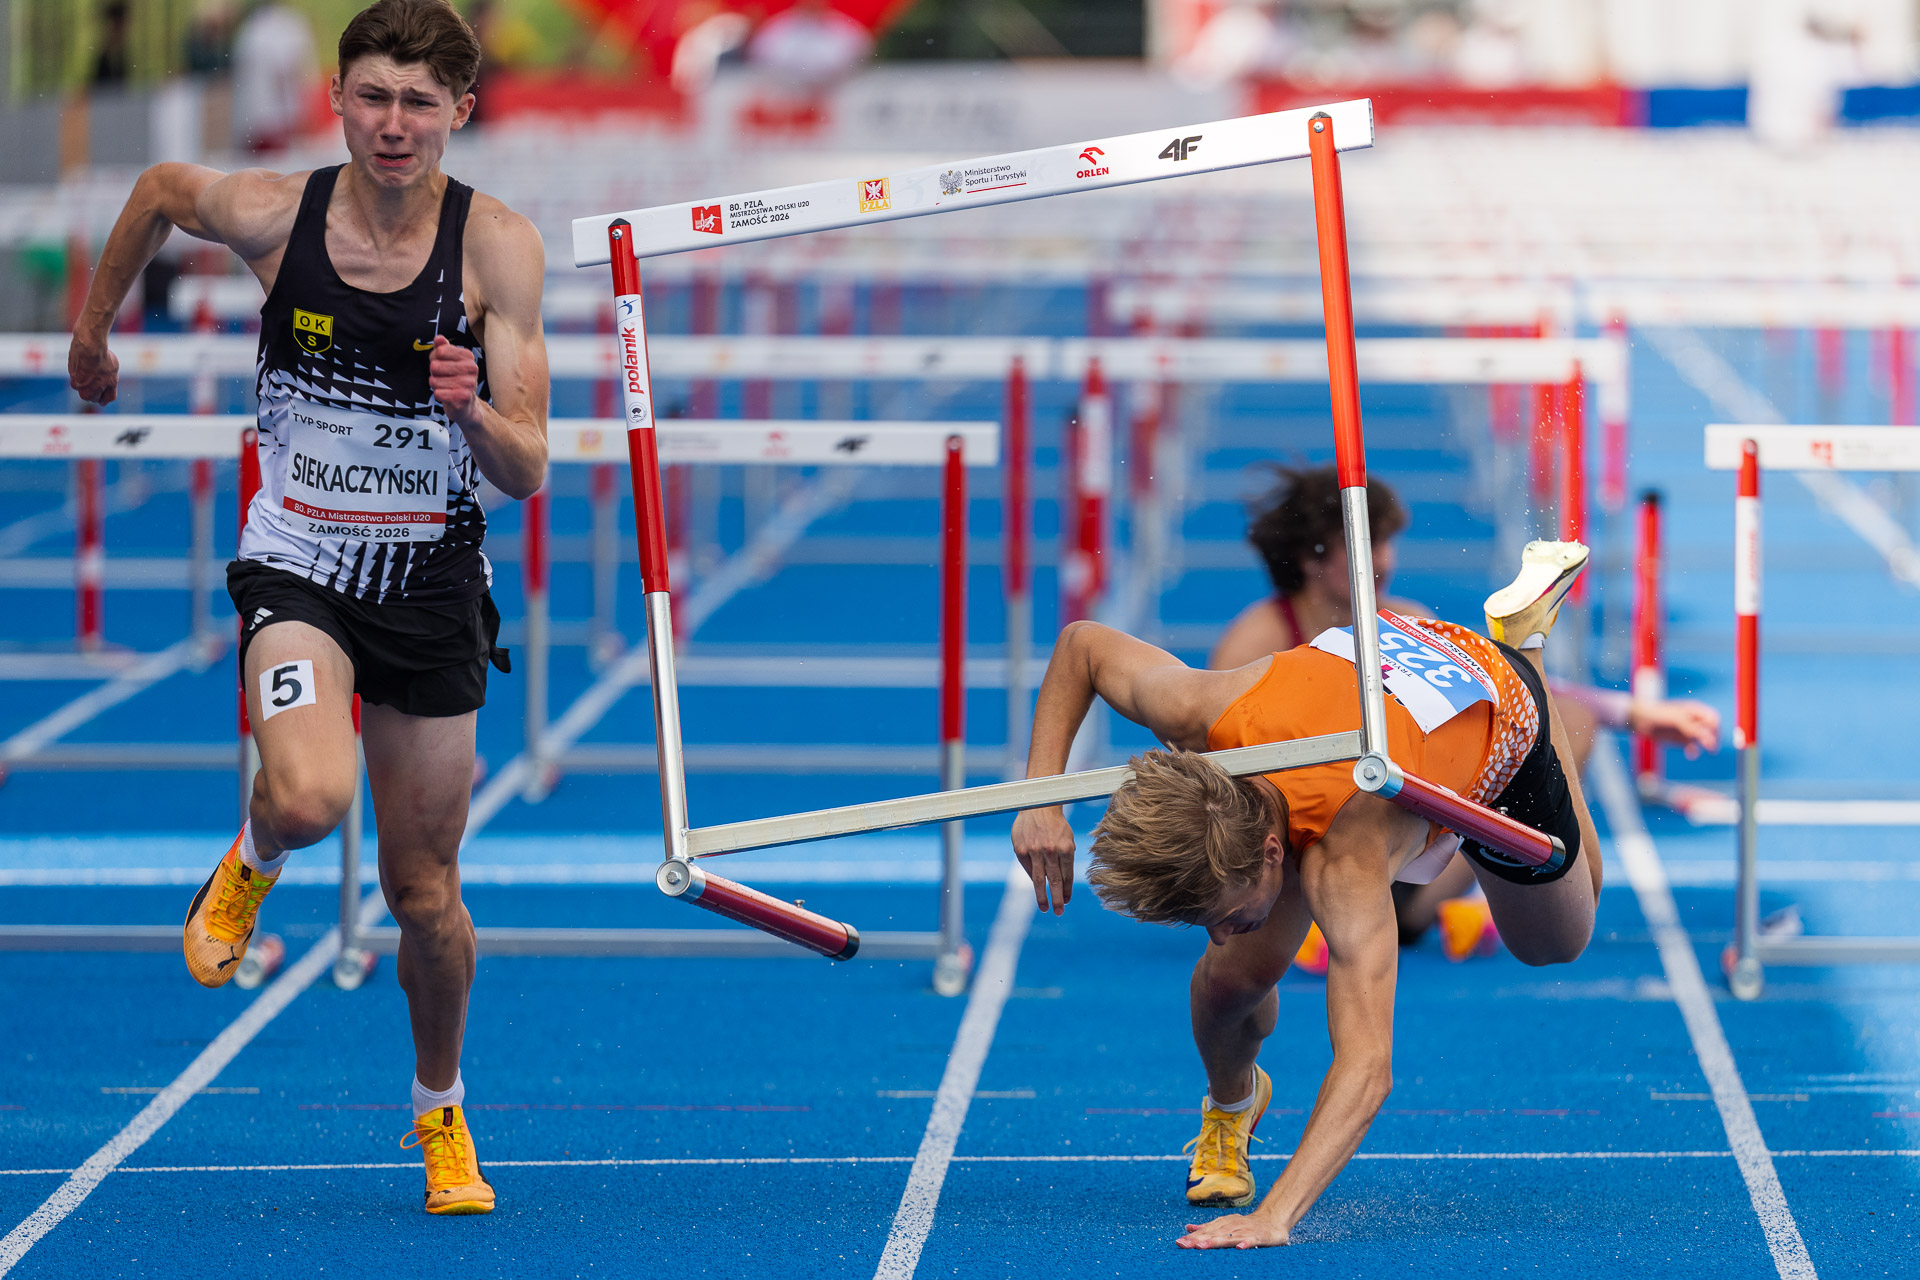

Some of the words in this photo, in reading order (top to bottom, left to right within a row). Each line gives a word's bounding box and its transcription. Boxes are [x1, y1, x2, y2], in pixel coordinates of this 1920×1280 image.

[1158, 135, 1203, 161] 4F
[964, 164, 1011, 177] Ministerstwo
[965, 177, 989, 187] Sportu
[994, 170, 1027, 183] Turystyki
[1076, 167, 1109, 178] ORLEN
[729, 203, 742, 212] 80.
[744, 199, 764, 209] PZLA
[729, 207, 773, 219] MISTRZOSTWA
[774, 203, 797, 212] POLSKI
[798, 200, 810, 208] U20
[861, 199, 889, 211] PZLA
[731, 214, 768, 229] ZAMOŚĆ
[769, 213, 790, 223] 2026
[621, 326, 645, 394] polanik
[293, 413, 314, 426] TVP
[316, 420, 353, 436] SPORT
[373, 423, 433, 450] 291
[291, 452, 438, 496] SIEKACZYŃSKI
[294, 503, 306, 514] 80.
[306, 508, 327, 519] PZLA
[328, 512, 383, 522] Mistrzostwa
[385, 513, 411, 522] Polski
[413, 514, 431, 522] U20
[308, 522, 371, 538] ZAMOŚĆ
[375, 527, 410, 538] 2026
[1390, 616, 1406, 629] U20
[1404, 623, 1428, 641] Polski
[1379, 631, 1472, 688] 325
[271, 664, 303, 707] 5
